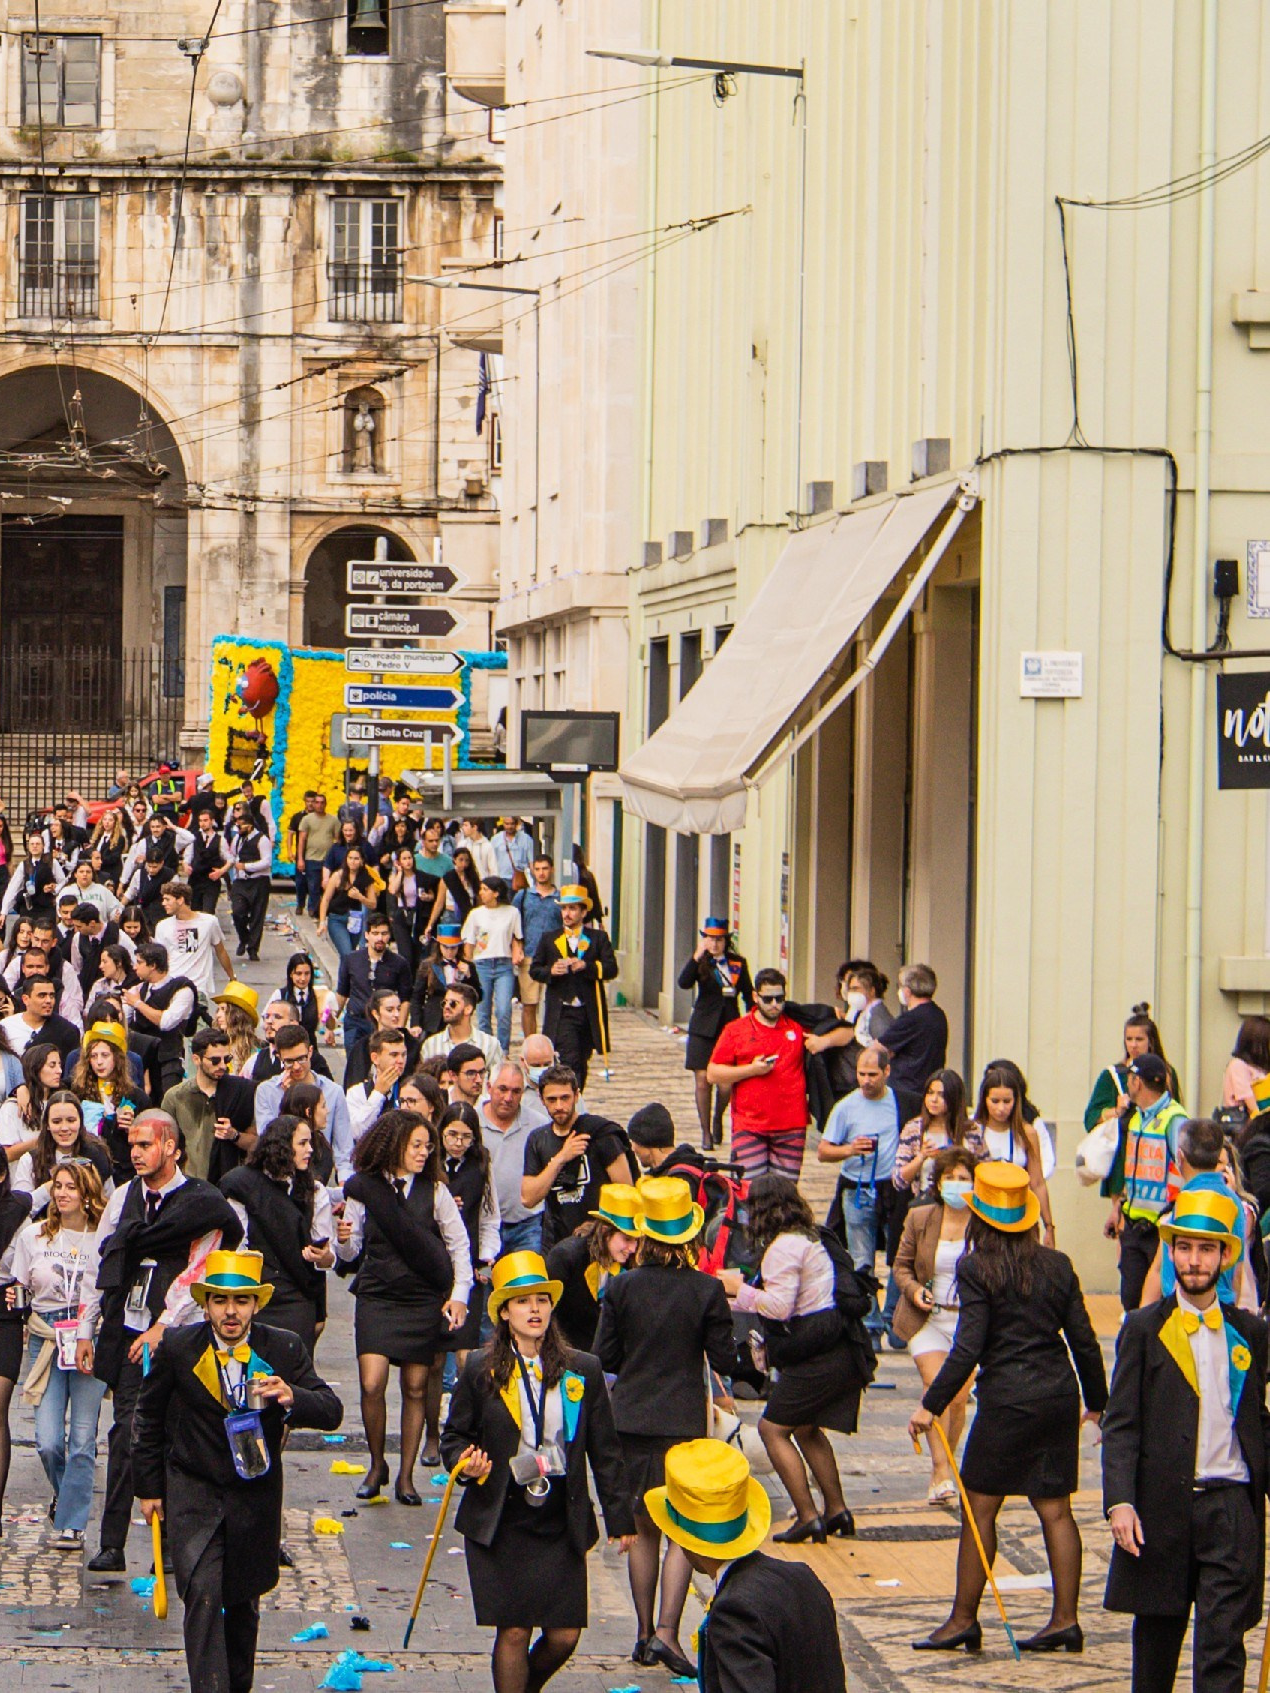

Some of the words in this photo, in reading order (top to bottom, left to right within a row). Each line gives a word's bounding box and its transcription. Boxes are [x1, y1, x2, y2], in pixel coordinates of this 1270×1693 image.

[379, 567, 434, 578] universidade
[392, 579, 402, 588] da
[404, 581, 444, 592] portagem
[379, 610, 410, 621] câmara
[378, 623, 420, 635] municipal
[404, 654, 445, 662] municipal
[377, 661, 401, 669] Pedro
[363, 690, 397, 702] polícia
[374, 727, 401, 737] Santa
[403, 728, 425, 738] Cruz
